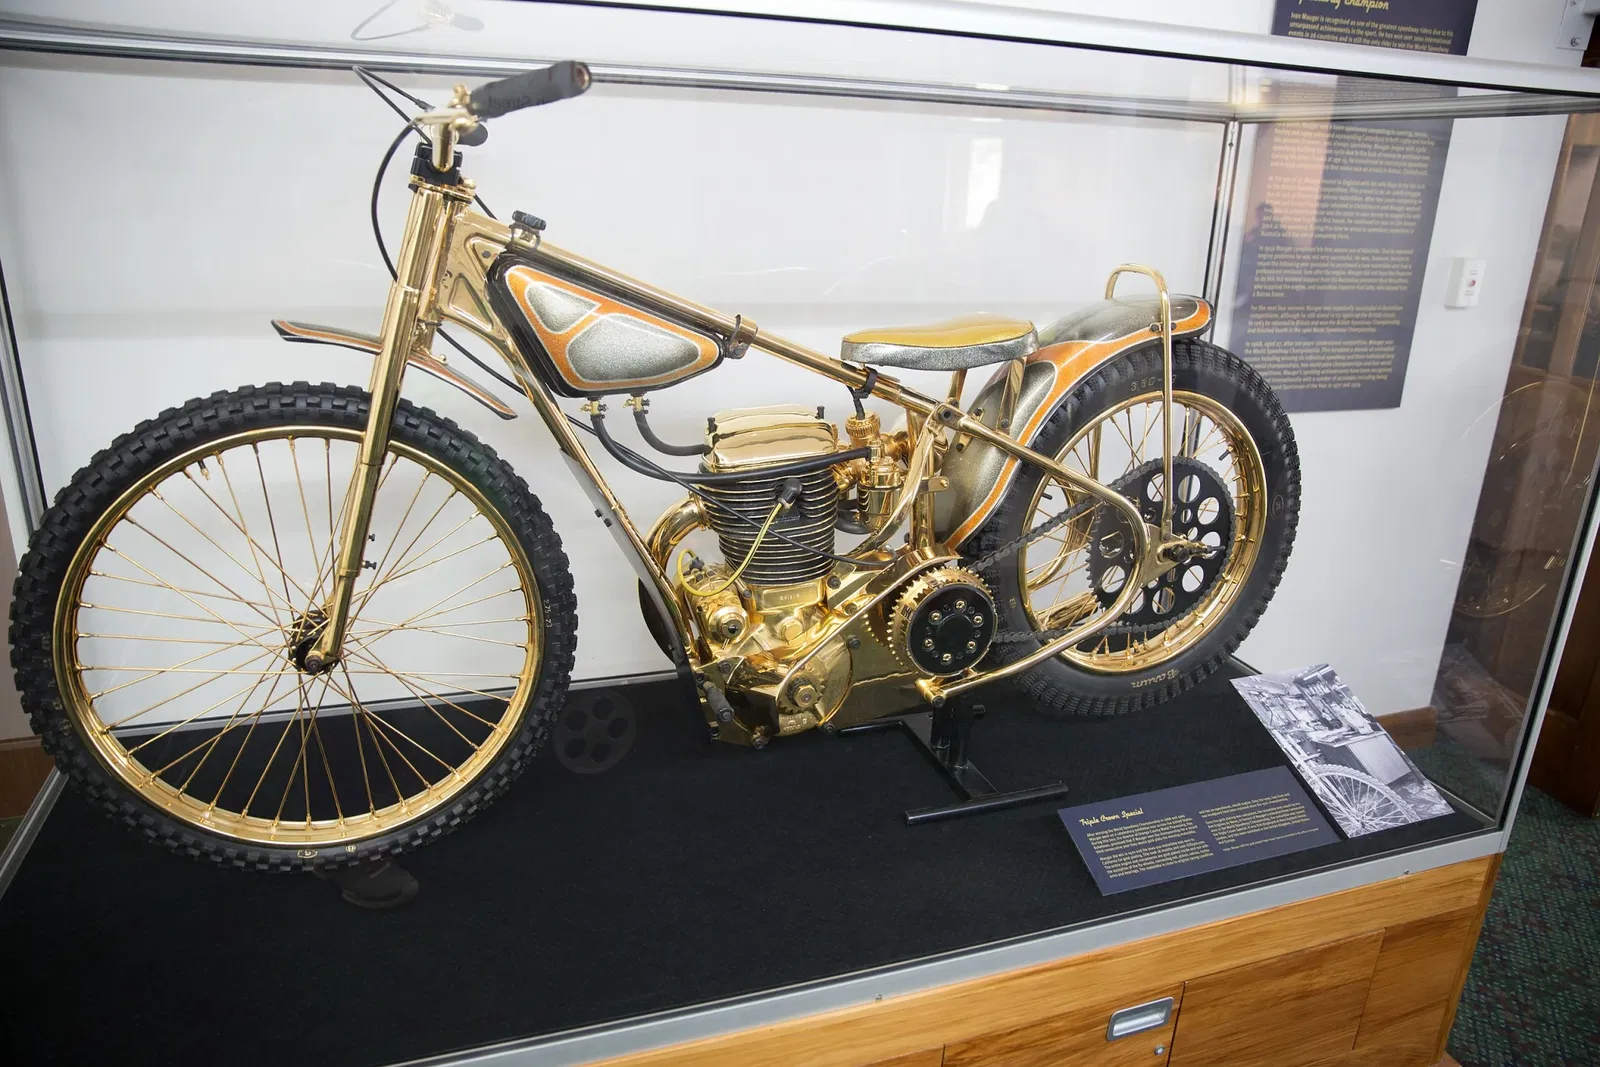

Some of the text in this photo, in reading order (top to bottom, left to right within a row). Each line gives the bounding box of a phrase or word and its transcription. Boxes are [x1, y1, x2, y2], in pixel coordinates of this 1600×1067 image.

[1131, 669, 1180, 688] Barum
[1079, 807, 1144, 827] Triple Crown Special
